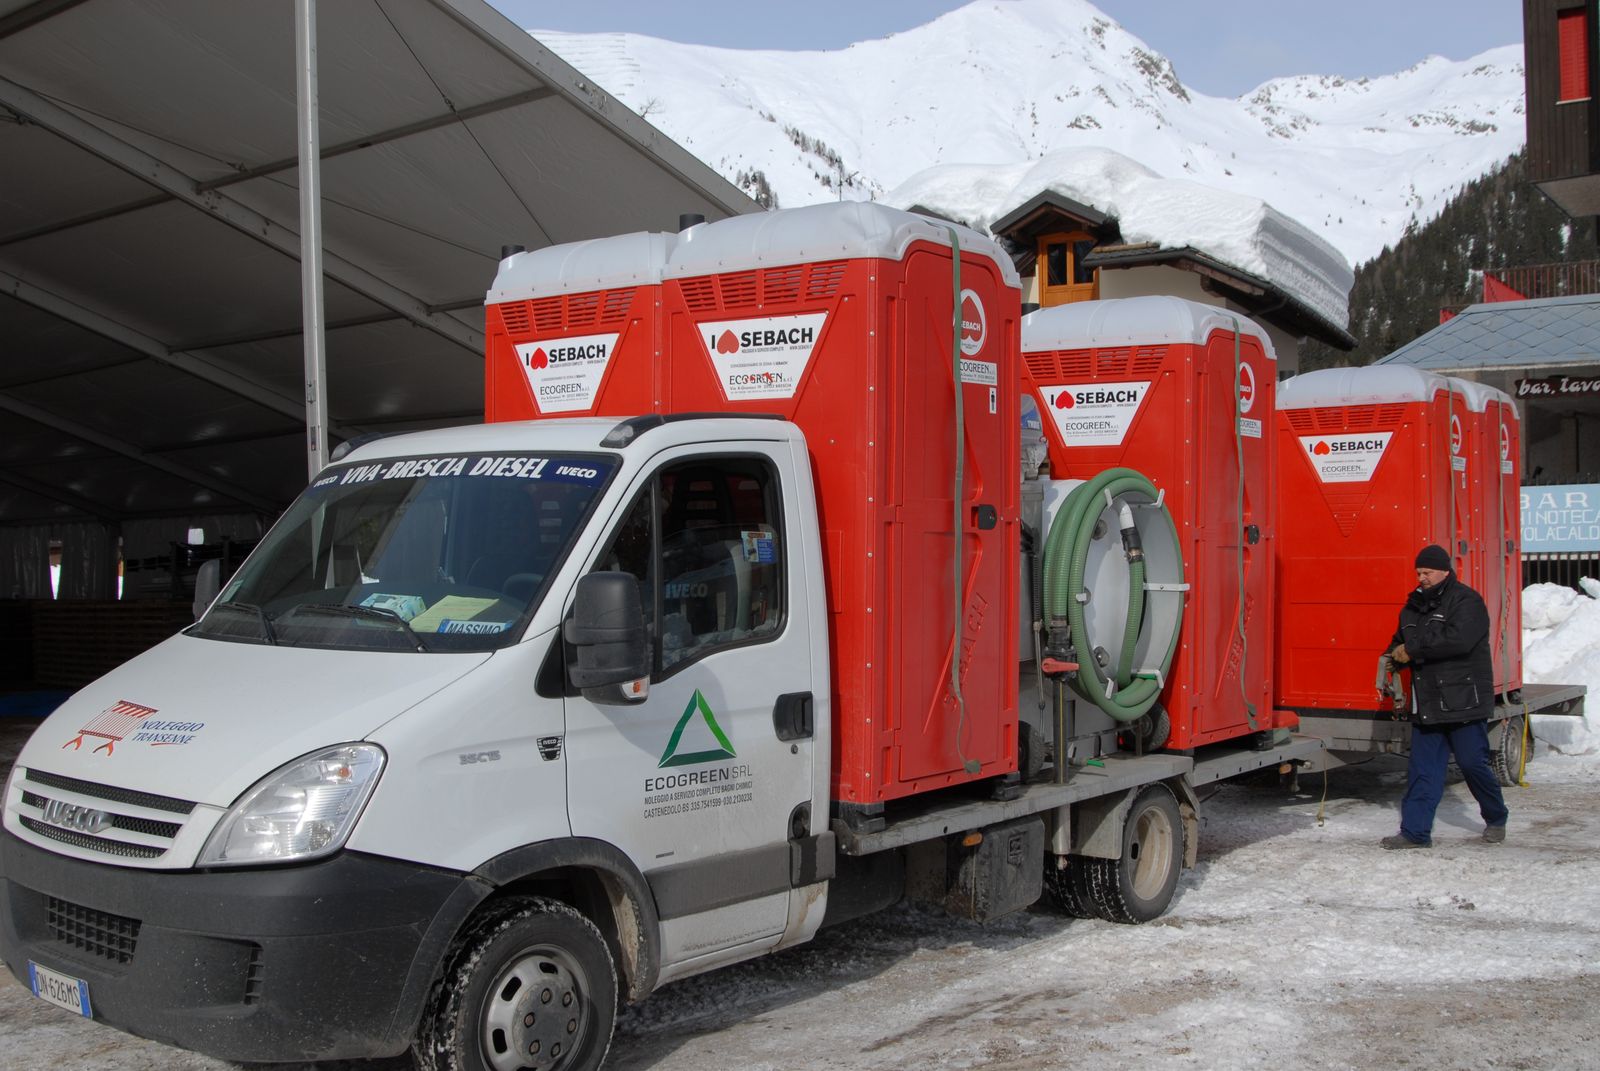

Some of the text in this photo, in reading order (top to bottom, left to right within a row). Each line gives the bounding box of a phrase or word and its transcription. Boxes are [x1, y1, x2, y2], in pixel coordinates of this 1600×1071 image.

[960, 321, 981, 331] EBACH
[711, 327, 813, 349] I SEBACH
[525, 353, 530, 366] I
[549, 344, 606, 363] SEBACH
[540, 383, 581, 396] ECOGREEN
[1050, 391, 1137, 405] I SEBACH
[1066, 421, 1111, 431] ECOGREEN
[1309, 440, 1383, 453] I SEBACH
[469, 456, 550, 479] DIESEL
[556, 465, 598, 479] IVECO
[1322, 465, 1361, 473] ECOGREEN
[666, 583, 709, 599] IVECO
[447, 623, 501, 634] MASSIMO
[139, 721, 205, 732] NOLEGGIO
[132, 733, 197, 744] TRANSENNE
[644, 764, 753, 792] ECOGREEN SRL
[644, 793, 669, 805] NOLEGGIO
[674, 790, 696, 801] SERVIZIO
[696, 786, 720, 798] COMPLETO
[721, 783, 736, 793] BAGNI
[736, 781, 753, 790] CHIMICI
[43, 799, 103, 834] IVECO
[643, 804, 682, 819] CASTENEDOLO
[682, 803, 690, 813] BS
